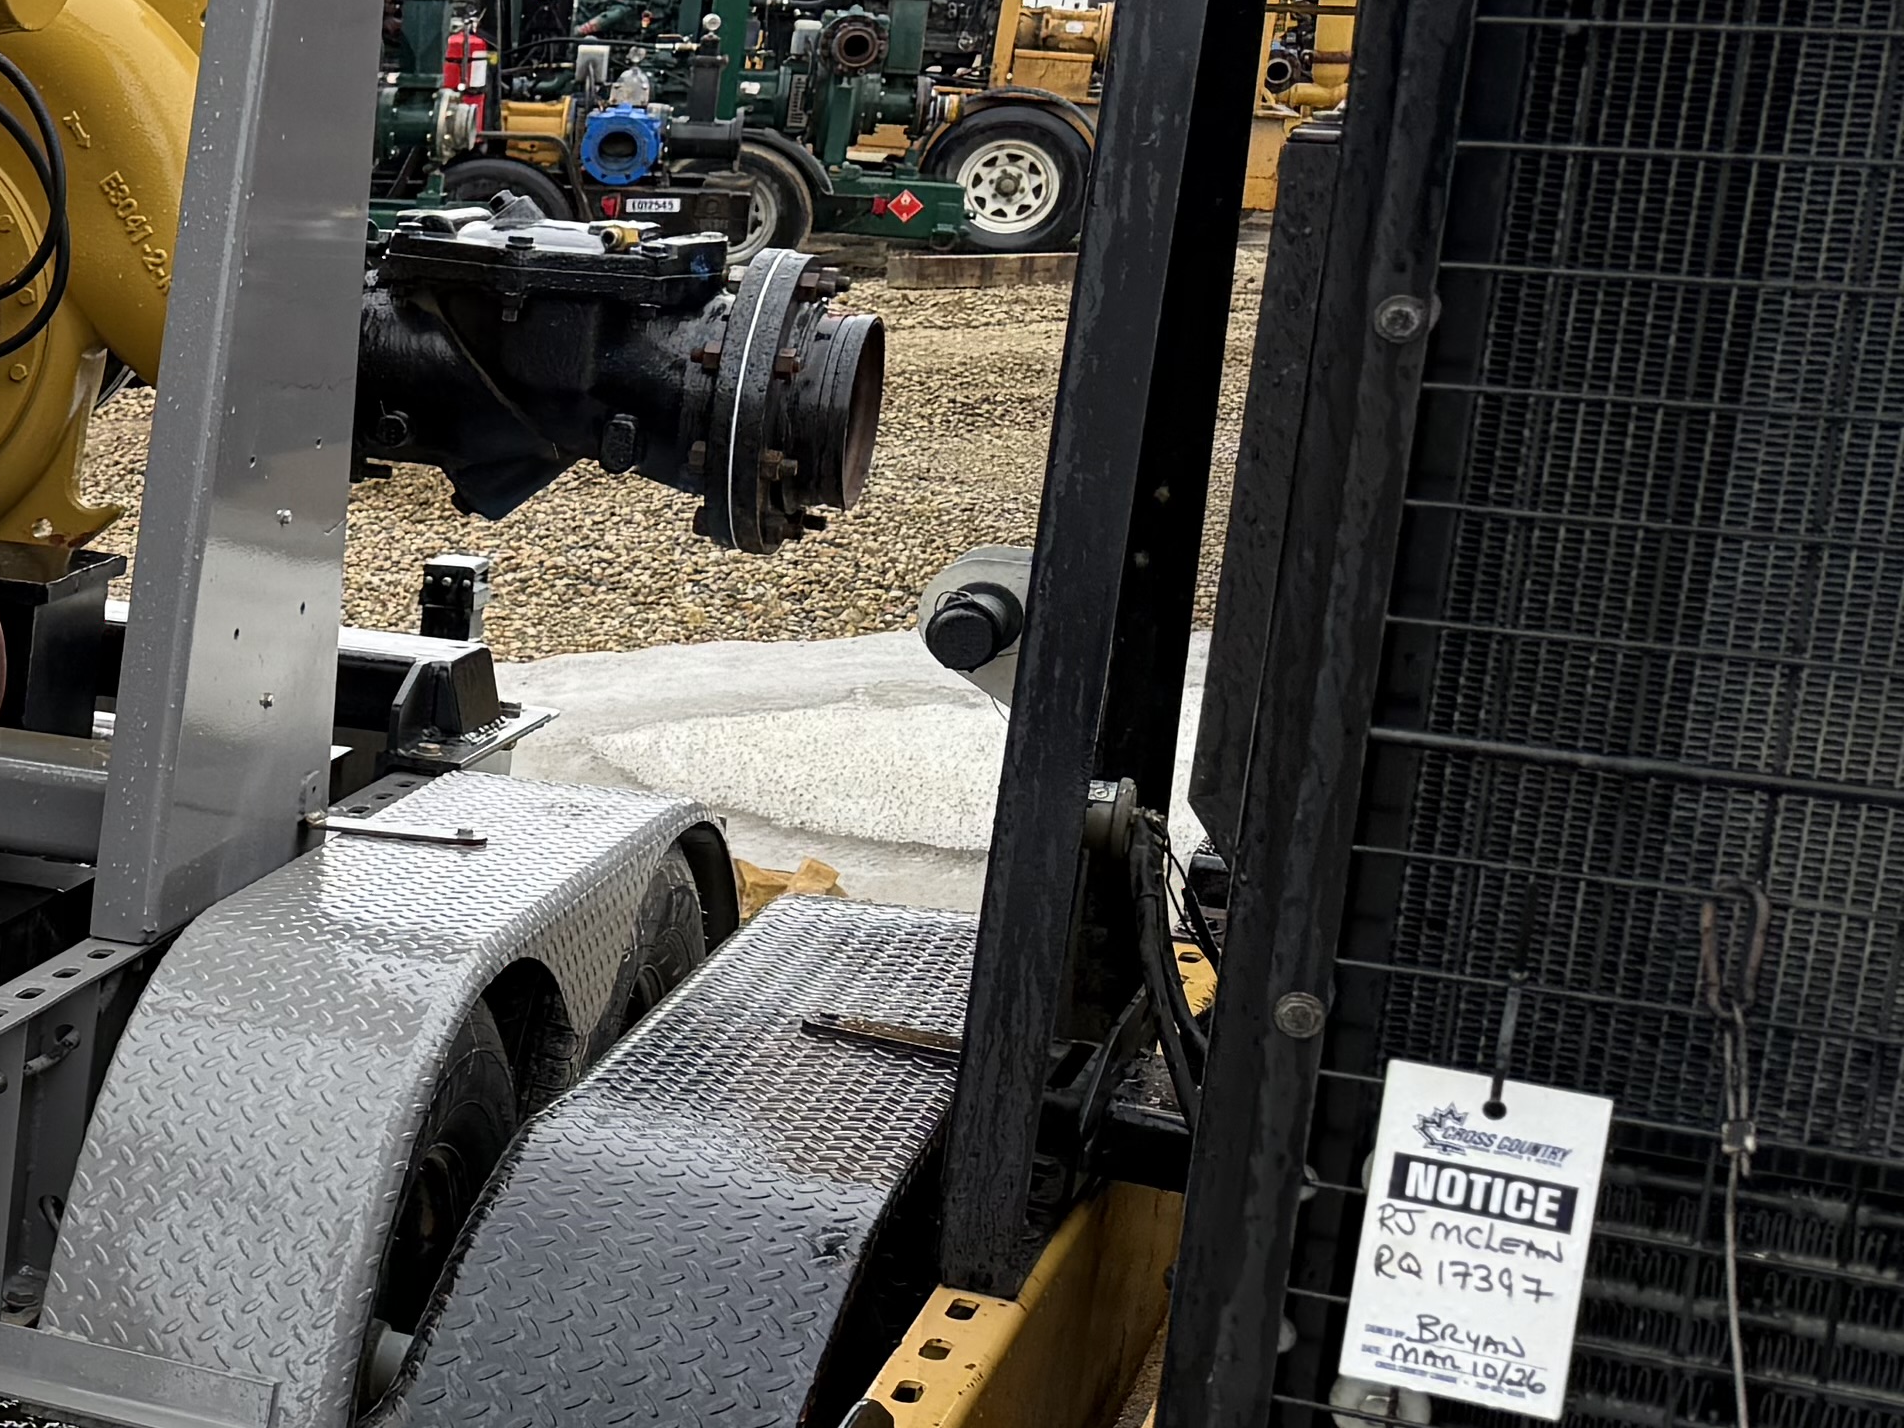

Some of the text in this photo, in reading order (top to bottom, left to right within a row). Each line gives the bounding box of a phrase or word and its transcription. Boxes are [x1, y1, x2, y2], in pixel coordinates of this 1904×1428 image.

[1442, 1125, 1498, 1148] CROSS
[1497, 1135, 1573, 1162] COUNTRY
[1404, 1161, 1563, 1227] NOTICE
[1374, 1244, 1555, 1303] RQ 17397
[1405, 1314, 1526, 1359] BRYAN
[1391, 1342, 1461, 1371] MAR
[1472, 1360, 1547, 1394] 10/26
